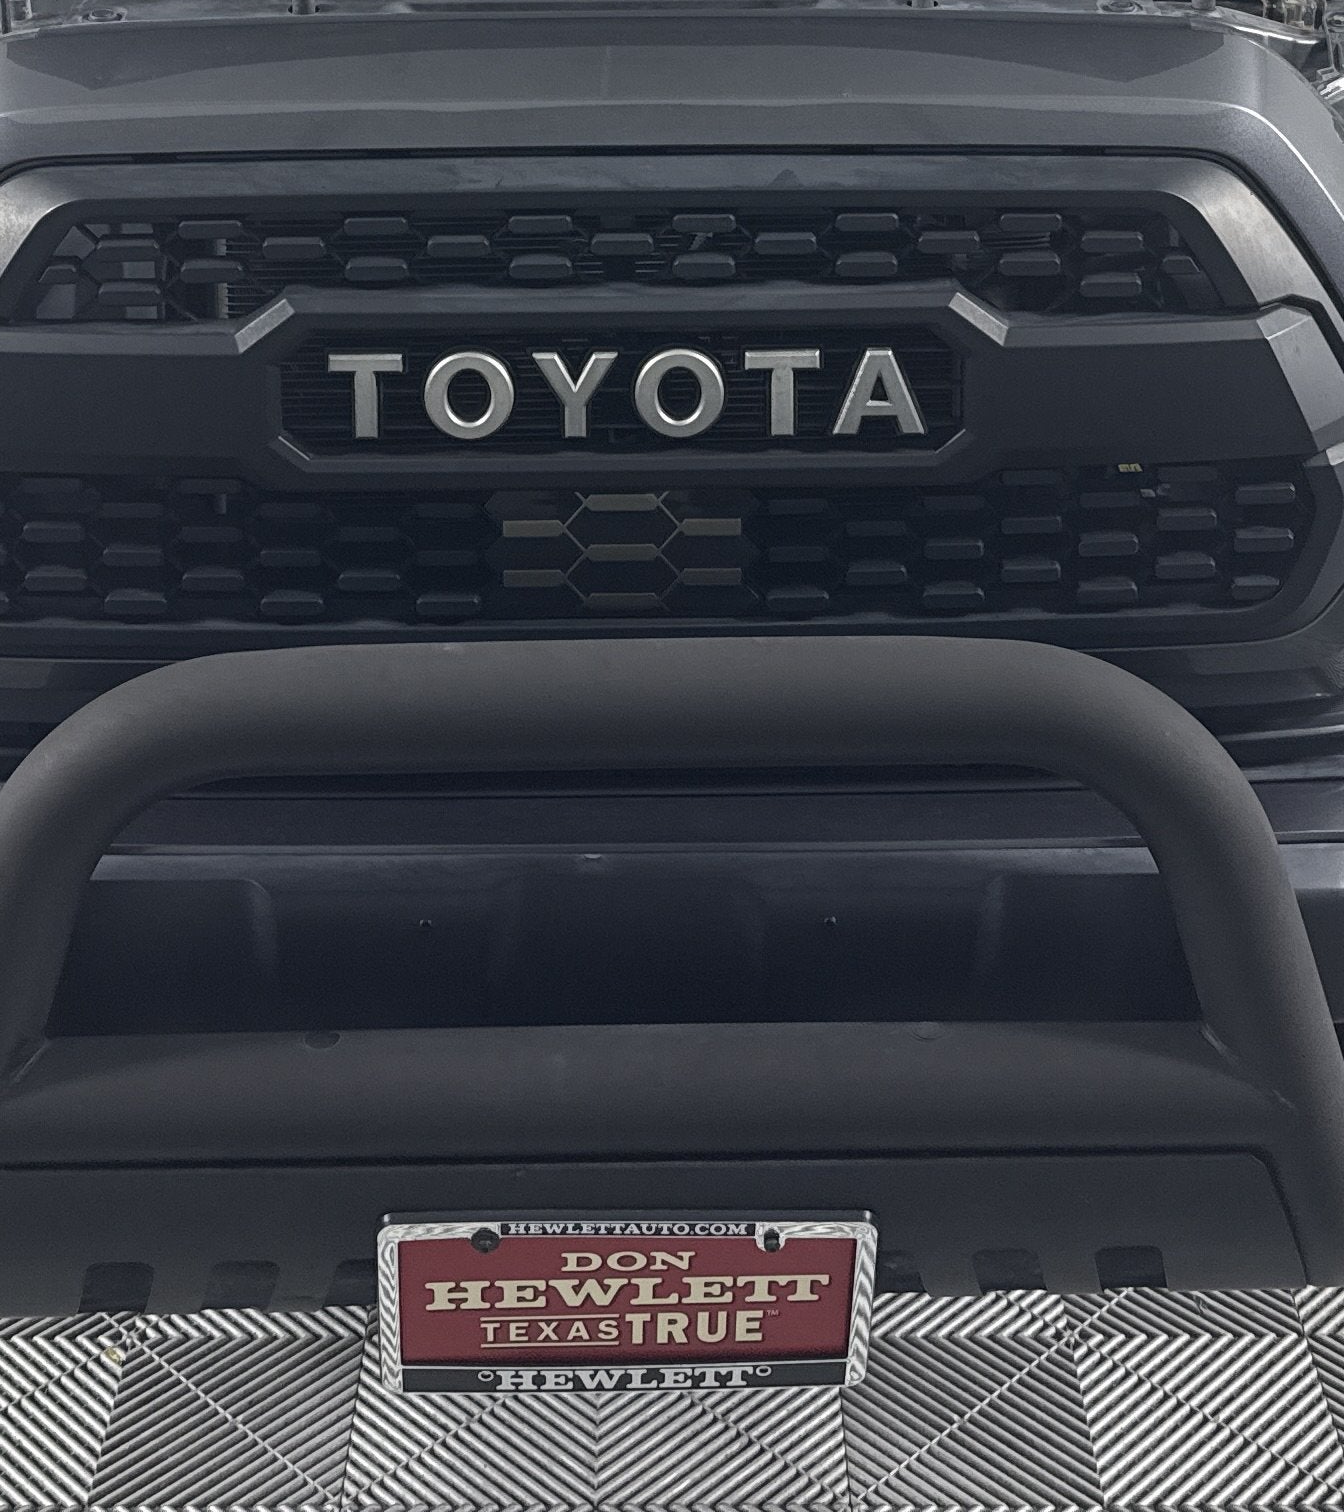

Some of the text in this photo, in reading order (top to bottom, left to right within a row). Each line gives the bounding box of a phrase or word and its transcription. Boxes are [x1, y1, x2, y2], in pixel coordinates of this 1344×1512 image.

[327, 346, 926, 440] TOYOTA
[507, 1222, 748, 1236] HEWLETTAUTO.COM
[560, 1250, 696, 1273] DON
[424, 1273, 831, 1312] HEWLETT
[495, 1365, 754, 1391] HEWLETT
